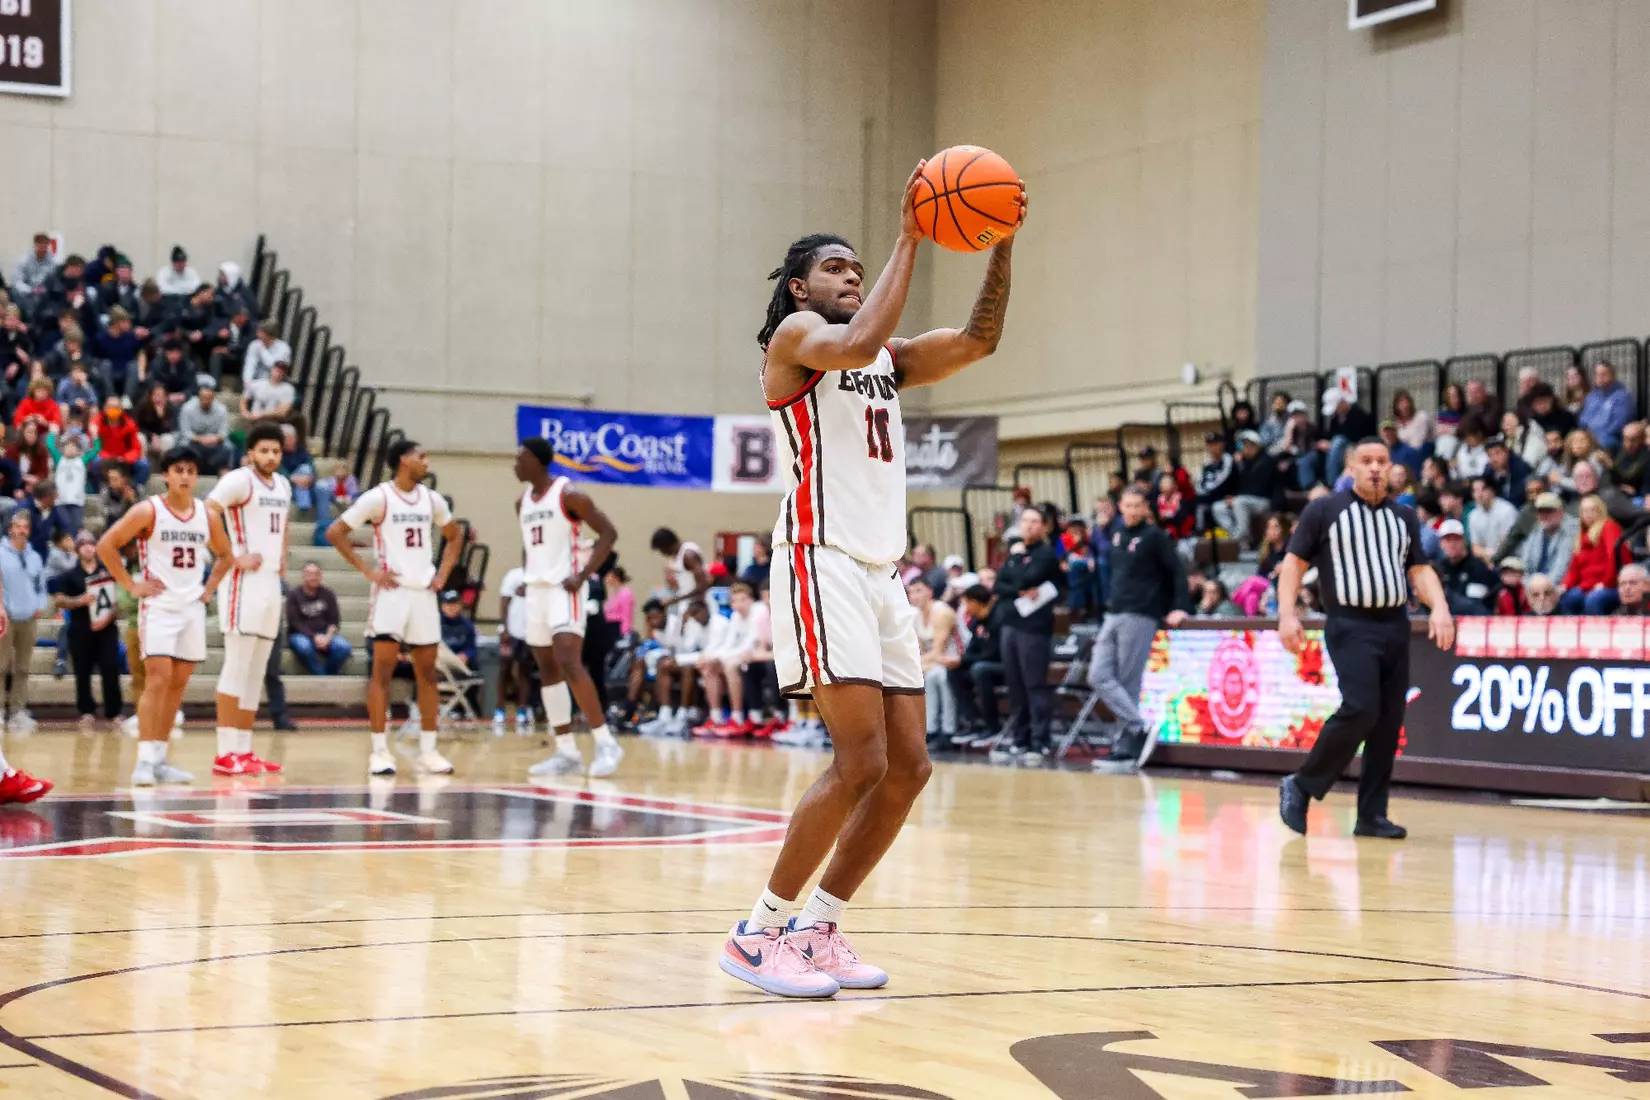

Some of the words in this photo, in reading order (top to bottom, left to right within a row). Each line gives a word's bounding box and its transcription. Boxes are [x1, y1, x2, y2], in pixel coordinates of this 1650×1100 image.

[0, 34, 44, 69] 19
[540, 418, 688, 464] BayCoast
[732, 426, 775, 482] B
[160, 529, 206, 542] BROWN
[404, 527, 423, 548] 21
[172, 546, 197, 569] 23
